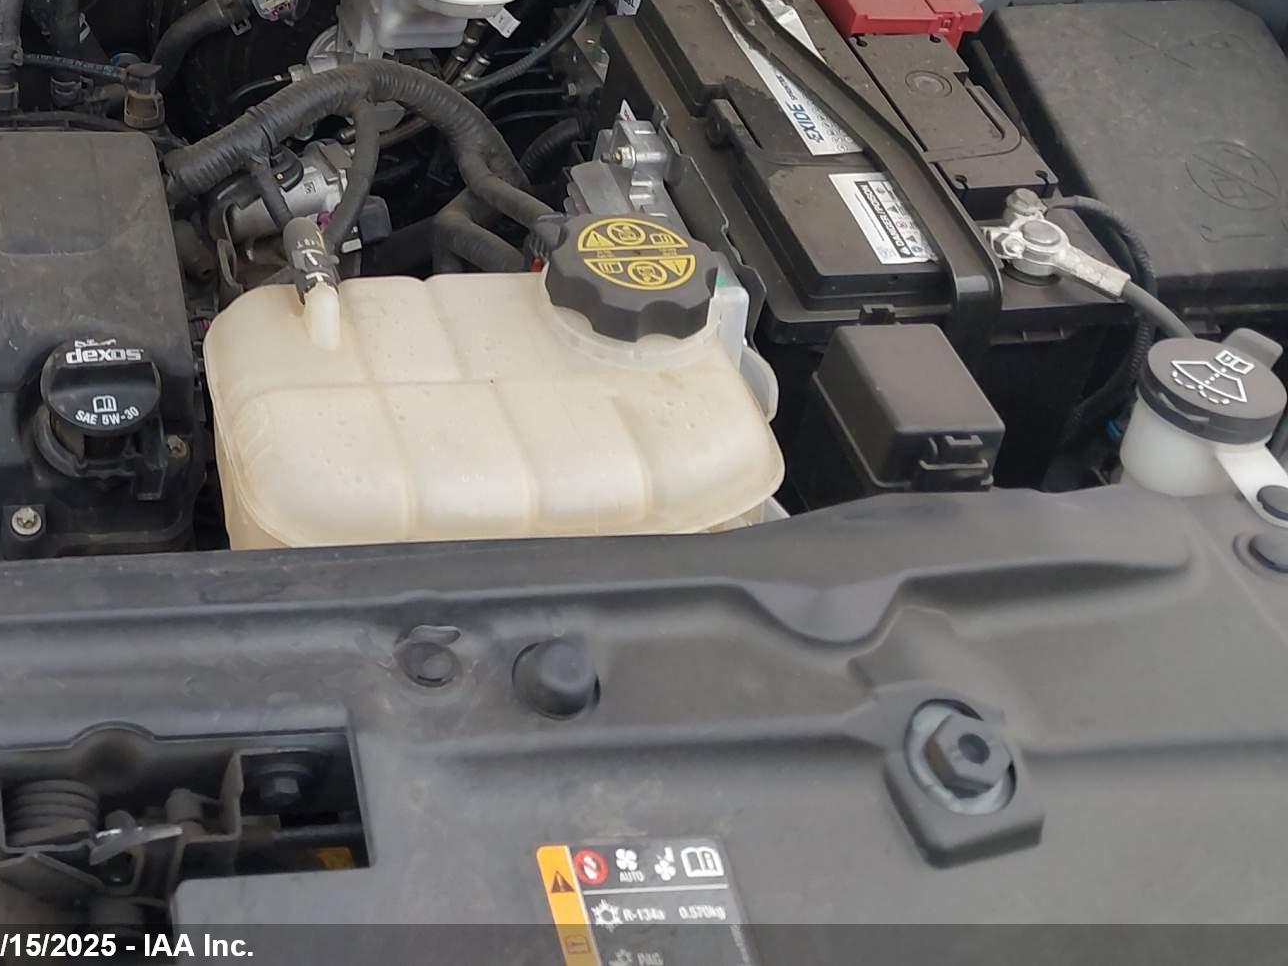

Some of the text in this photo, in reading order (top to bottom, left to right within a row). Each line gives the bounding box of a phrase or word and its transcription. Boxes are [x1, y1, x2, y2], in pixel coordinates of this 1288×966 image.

[65, 348, 142, 364] dexos
[75, 406, 139, 425] SAE 5W-30
[619, 871, 645, 882] AUTO
[623, 907, 665, 922] R-134a
